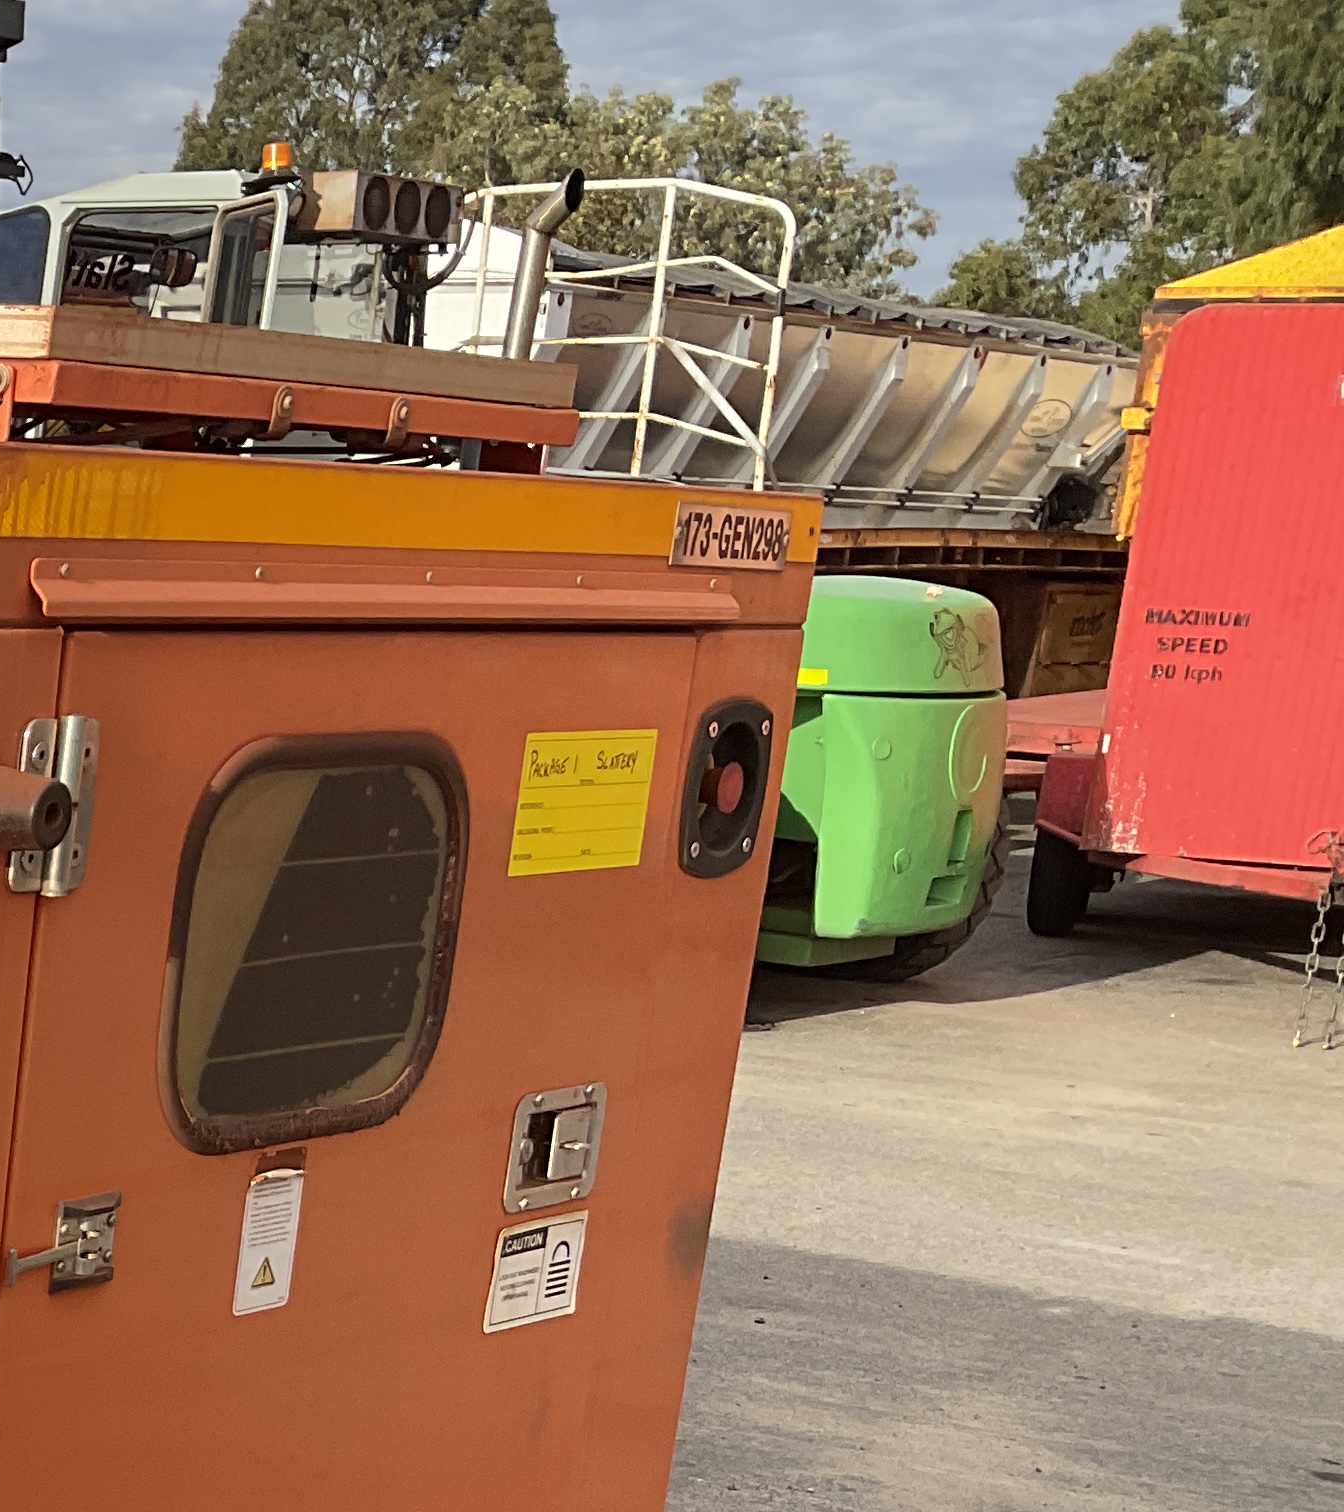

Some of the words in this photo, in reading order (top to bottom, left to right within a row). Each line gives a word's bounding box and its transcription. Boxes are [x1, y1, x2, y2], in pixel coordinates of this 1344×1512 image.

[682, 511, 784, 562] 173-GEN298
[1145, 607, 1251, 628] MAXIMUM
[1156, 636, 1229, 655] SPEED
[505, 1231, 544, 1253] CAUTION
